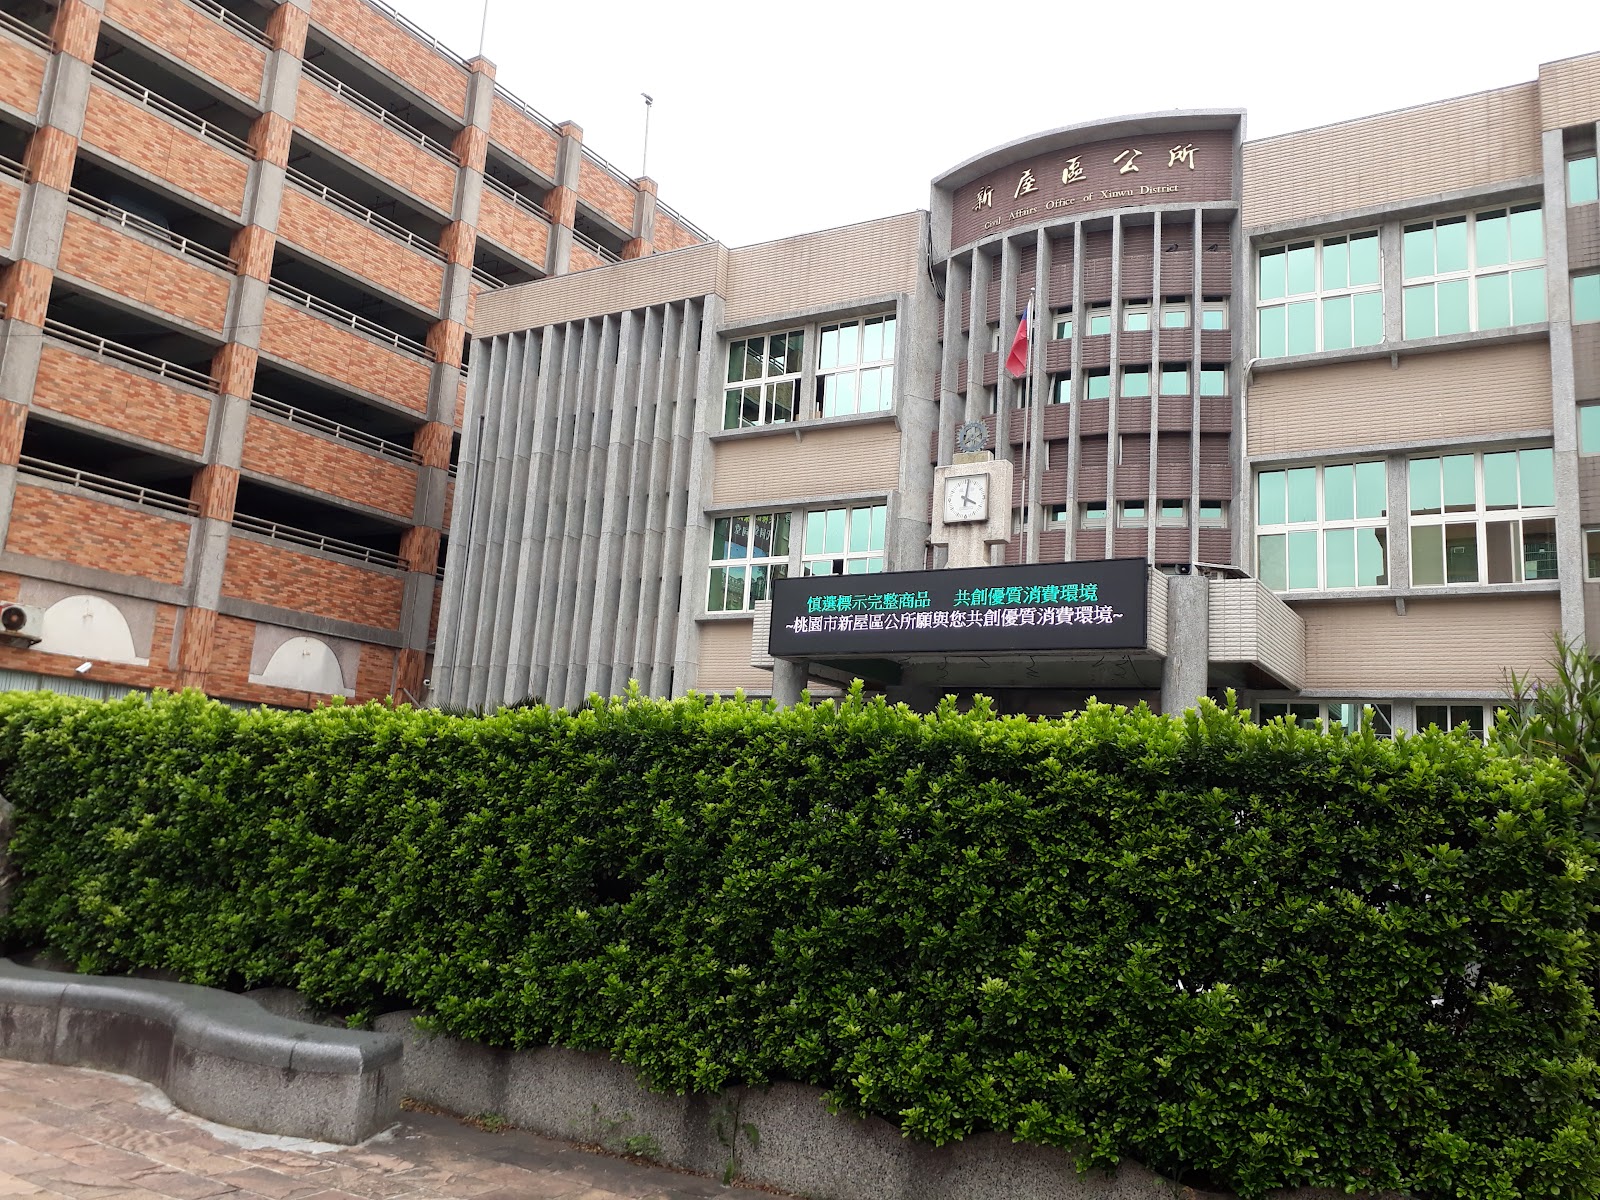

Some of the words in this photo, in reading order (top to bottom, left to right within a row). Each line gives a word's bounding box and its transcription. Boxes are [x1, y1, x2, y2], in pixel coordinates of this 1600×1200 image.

[973, 143, 1199, 210] 新屋區公所
[984, 217, 1002, 231] Civil
[1008, 204, 1038, 221] Affairs
[1045, 196, 1076, 210] Office
[1083, 192, 1094, 202] of
[1100, 187, 1134, 200] Xinwu
[1139, 183, 1180, 195] District
[807, 590, 931, 613] 慎選標示完整商品
[953, 582, 1099, 607] 共創優質消費環境
